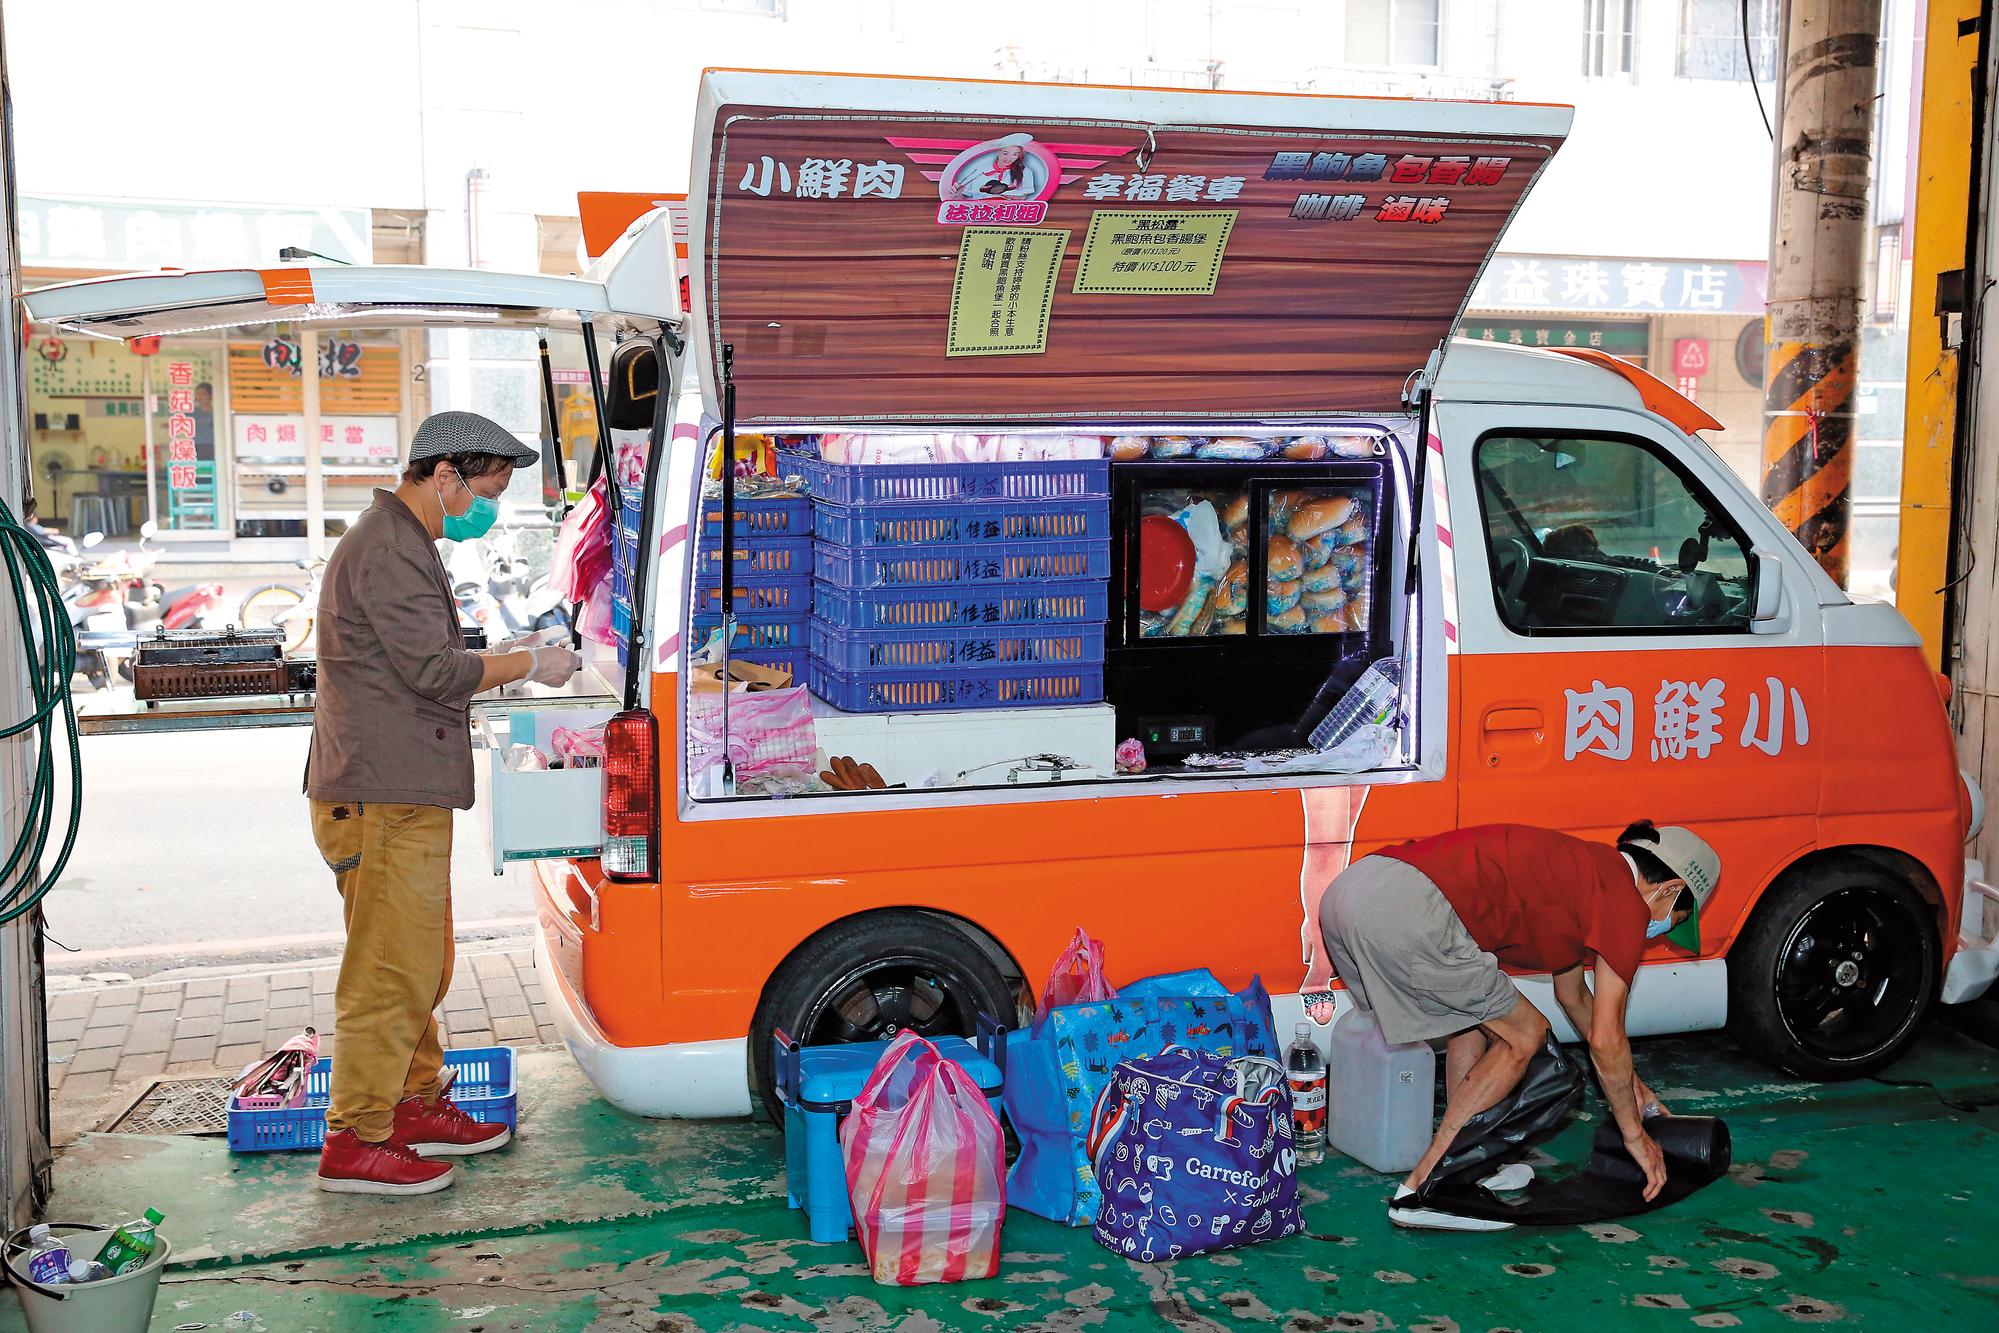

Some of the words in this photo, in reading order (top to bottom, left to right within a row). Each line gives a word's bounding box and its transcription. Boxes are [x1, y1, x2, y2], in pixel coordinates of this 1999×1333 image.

[738, 155, 906, 199] 小鮮肉
[1264, 151, 1388, 182] 黑鮑魚
[1389, 155, 1512, 186] 包香腸
[1082, 173, 1247, 202] 幸福餐車
[1289, 193, 1369, 221] 咖啡
[1373, 194, 1452, 223] 滷味
[1136, 218, 1180, 231] 黑松露
[1111, 233, 1208, 246] 黑鮑魚包香腸堡
[981, 247, 997, 270] 謝謝
[1111, 261, 1138, 273] 特價
[1138, 260, 1182, 273] NT$100
[1181, 261, 1197, 273] 元
[168, 362, 197, 488] 香菇肉燥飯
[964, 560, 1002, 580] 佳益
[961, 602, 1000, 623] 佳益
[960, 640, 997, 661] 佳益
[1185, 1157, 1270, 1189] Carrefour
[1240, 1182, 1281, 1208] Salut!
